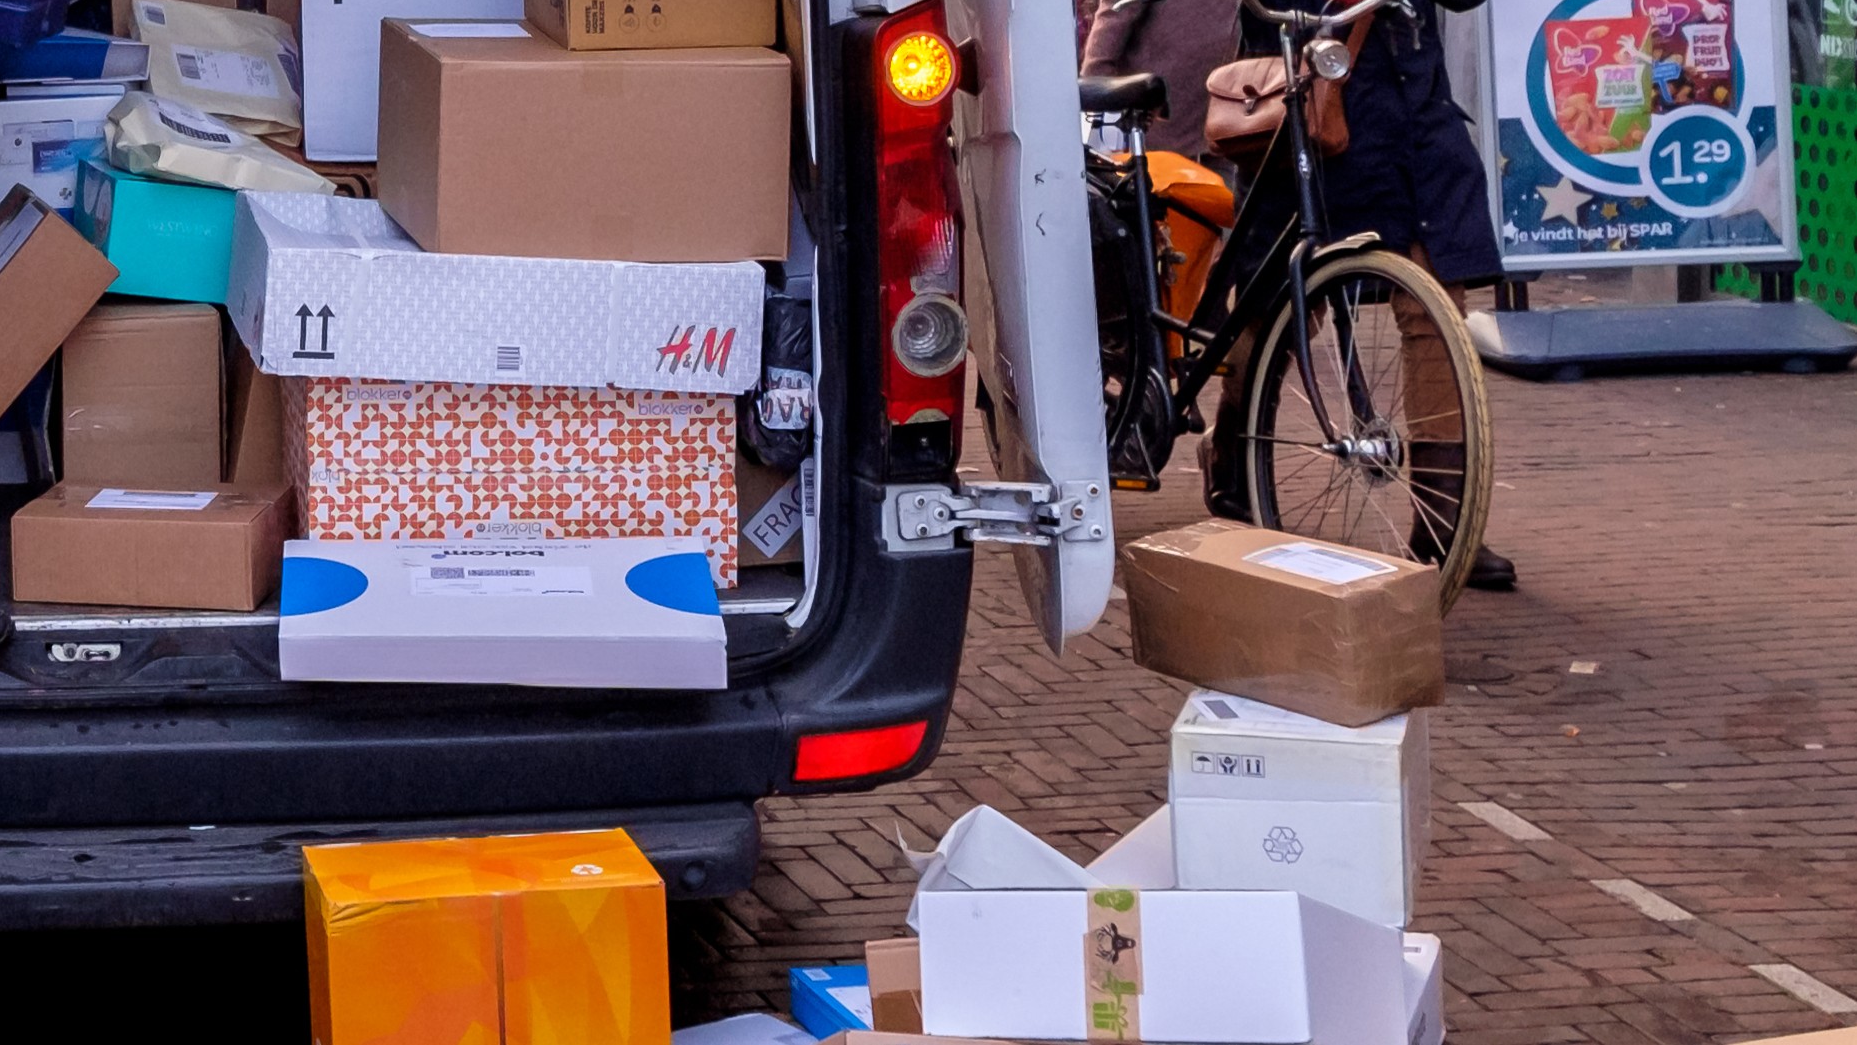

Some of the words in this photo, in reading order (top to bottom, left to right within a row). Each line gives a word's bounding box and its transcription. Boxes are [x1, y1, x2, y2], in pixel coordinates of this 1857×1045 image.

[1658, 139, 1731, 185] 1.29
[1531, 227, 1574, 241] vindt
[1607, 224, 1628, 245] bij
[1630, 222, 1673, 237] SPAR
[656, 324, 737, 378] H&M
[346, 388, 400, 401] blokker
[638, 403, 693, 416] blokker
[488, 523, 542, 535] blokker
